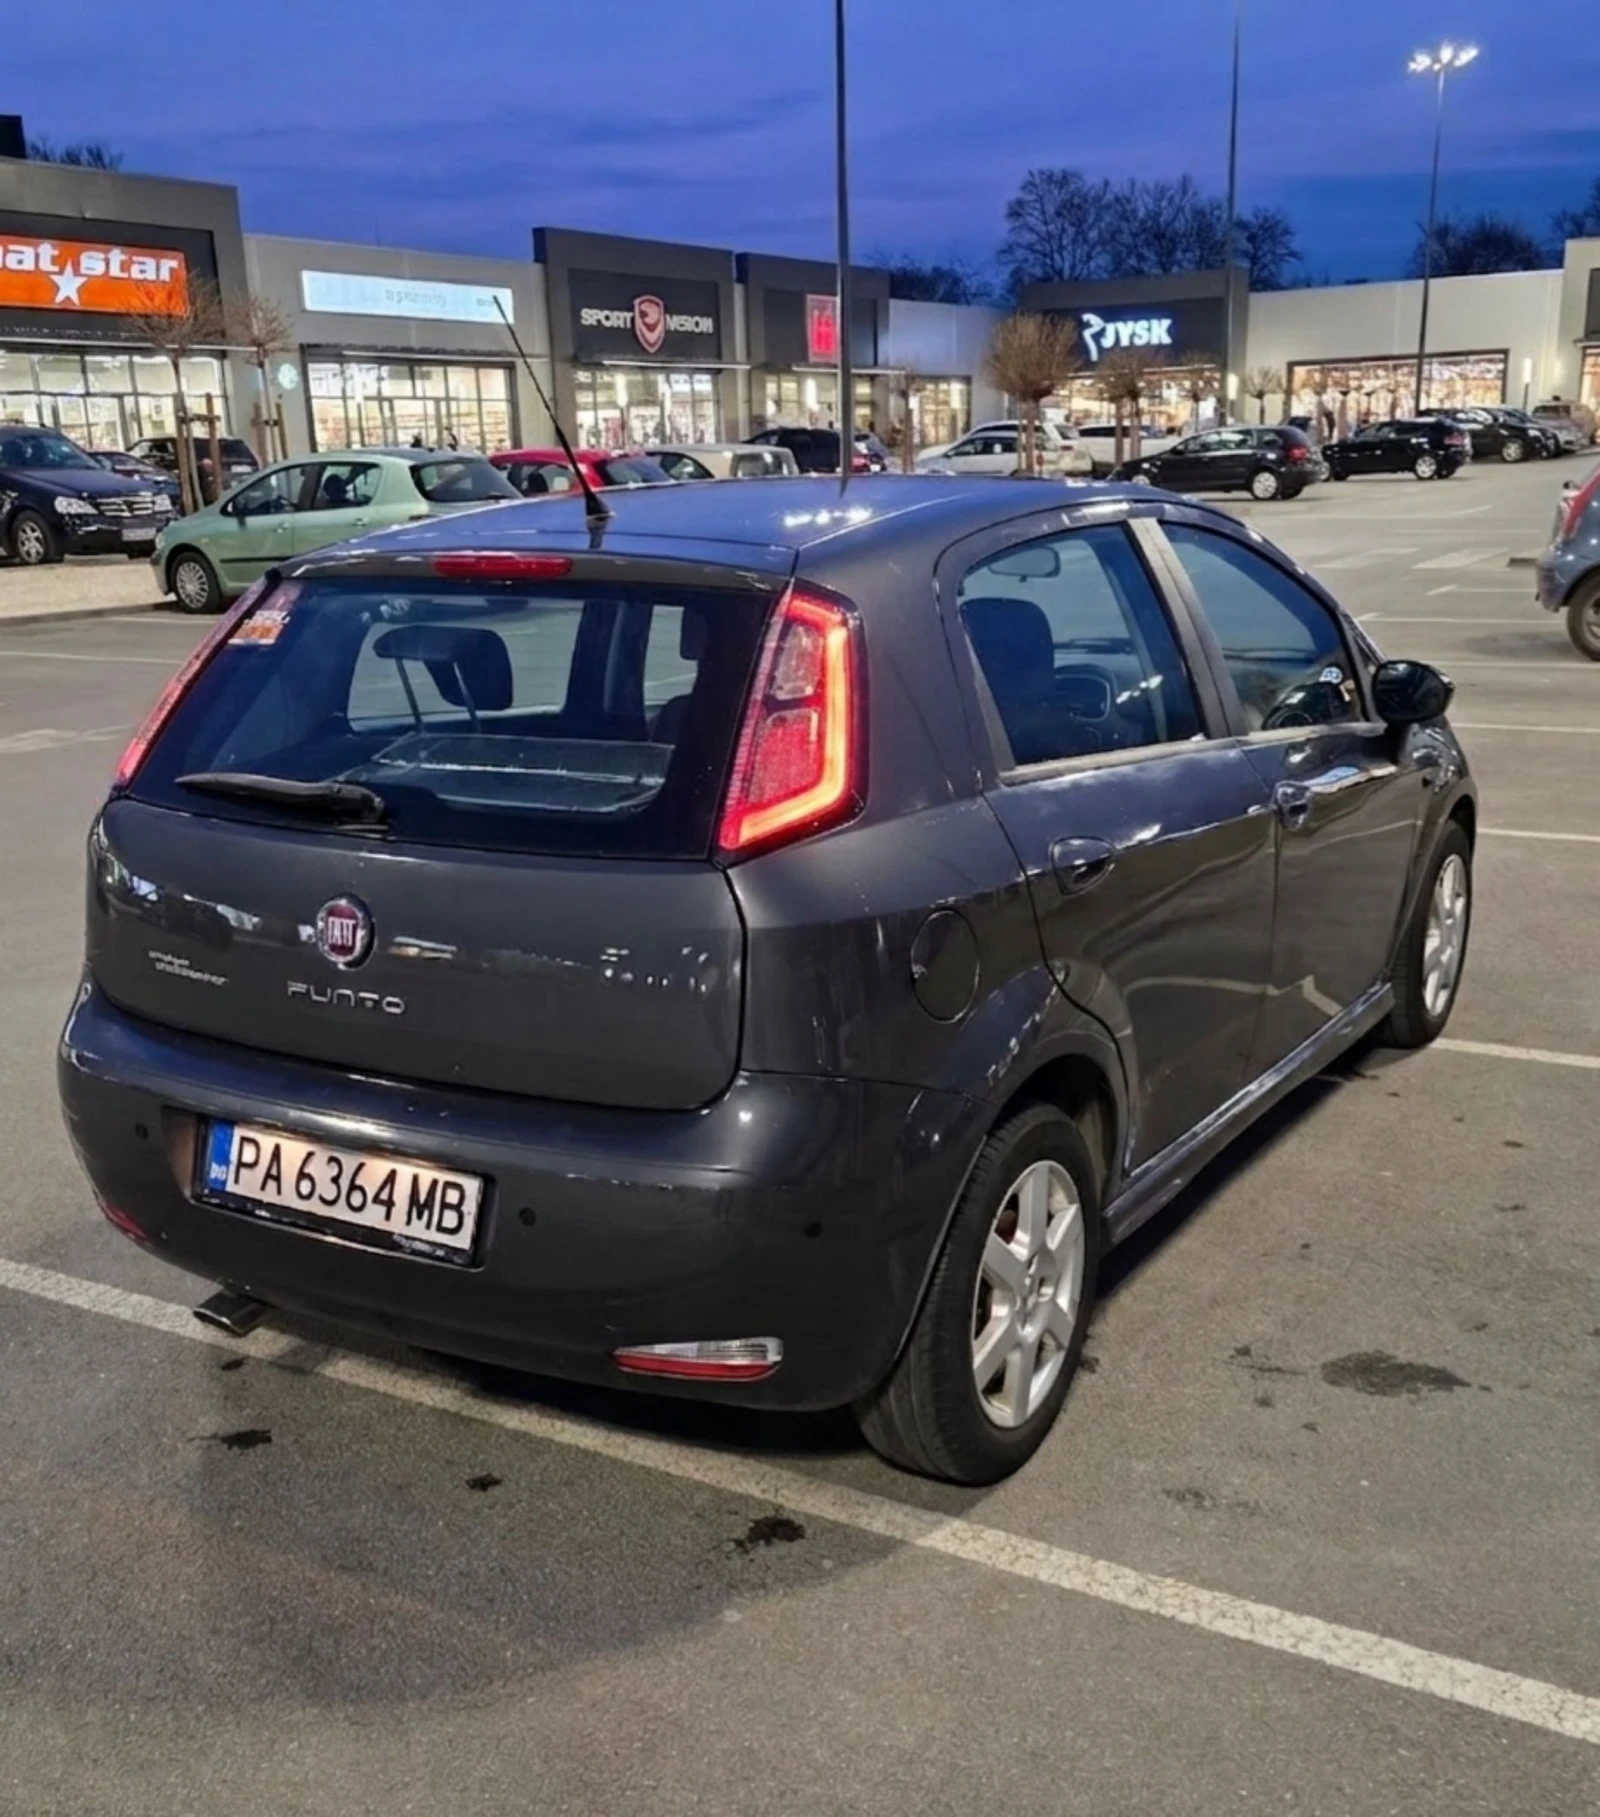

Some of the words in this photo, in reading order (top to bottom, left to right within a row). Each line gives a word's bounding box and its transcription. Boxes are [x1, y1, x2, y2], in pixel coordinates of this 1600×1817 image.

[0, 241, 60, 272] at
[79, 247, 178, 281] star
[580, 307, 634, 328] SPORT
[1100, 318, 1173, 349] JYSK
[233, 1136, 282, 1196] PA
[295, 1151, 397, 1222] 6364
[406, 1173, 466, 1236] MB
